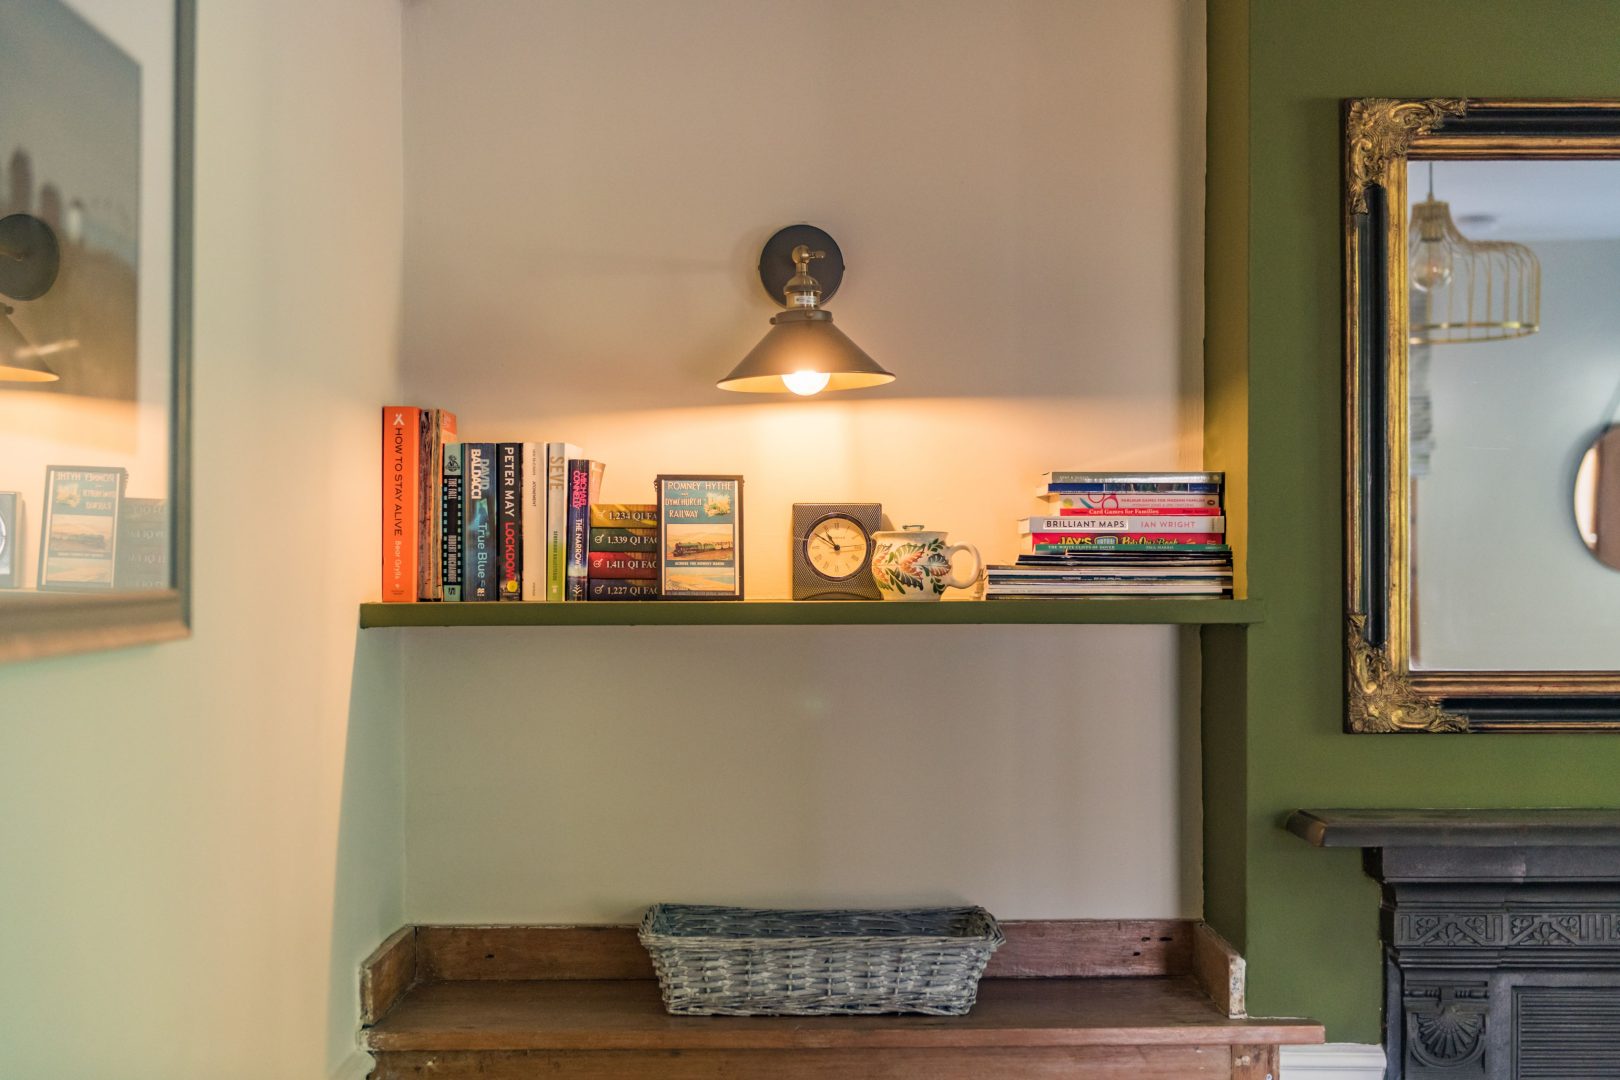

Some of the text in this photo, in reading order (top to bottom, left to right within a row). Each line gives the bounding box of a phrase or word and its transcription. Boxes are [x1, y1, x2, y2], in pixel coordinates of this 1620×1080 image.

[394, 428, 403, 536] HOW TO STAY ALIVE
[471, 448, 482, 500] BALDACCI
[480, 458, 490, 490] DAVID
[504, 447, 514, 517] PETER MAY
[550, 456, 564, 491] SEVE
[448, 478, 457, 500] THE FALL
[572, 470, 581, 510] CONNELLY
[580, 472, 588, 506] MICHAEL
[668, 481, 732, 490] ROMNEY HYTHE
[665, 498, 702, 506] DYMCHURCH
[575, 518, 583, 532] THE
[633, 512, 644, 521] QI
[669, 510, 698, 518] RAILWAY
[1046, 520, 1125, 528] BRILLIANT MAPS
[448, 534, 457, 552] ROBERT
[478, 522, 488, 550] True
[608, 536, 628, 544] 1,339
[630, 536, 640, 545] QI
[504, 522, 516, 581] LOCKDOW
[478, 552, 488, 578] Blue
[628, 560, 639, 570] QI
[630, 587, 640, 595] QI
